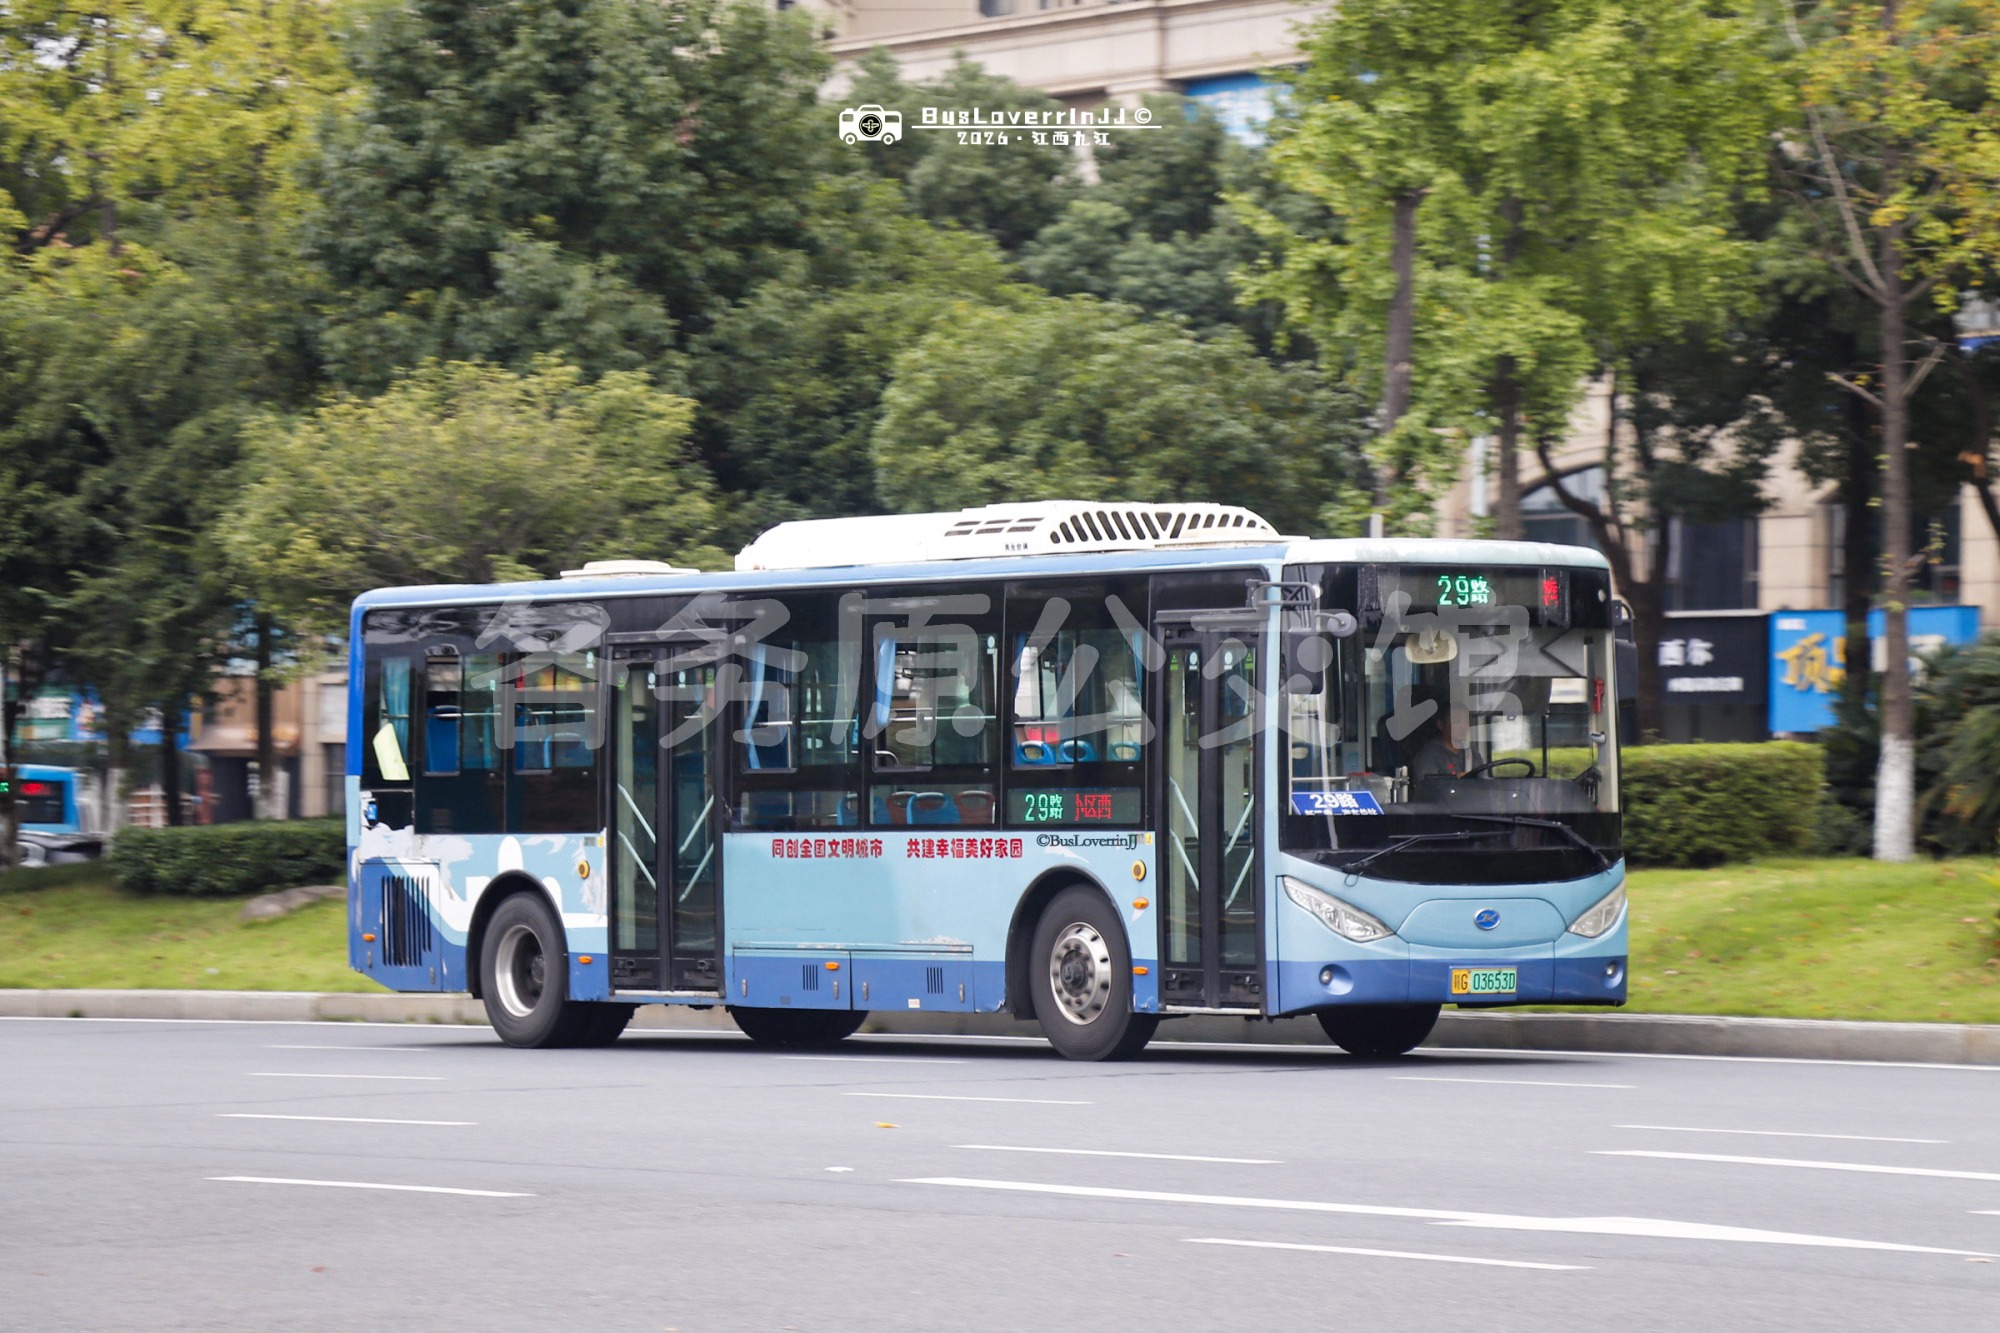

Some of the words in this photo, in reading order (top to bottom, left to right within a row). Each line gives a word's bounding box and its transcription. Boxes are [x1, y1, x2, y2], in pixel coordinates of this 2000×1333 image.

[1437, 575, 1490, 606] 29路
[1025, 793, 1064, 821] 29路
[1309, 792, 1360, 809] 29路
[772, 838, 883, 859] 同创全国文明城市
[907, 838, 1023, 859] 共建幸福美好家园
